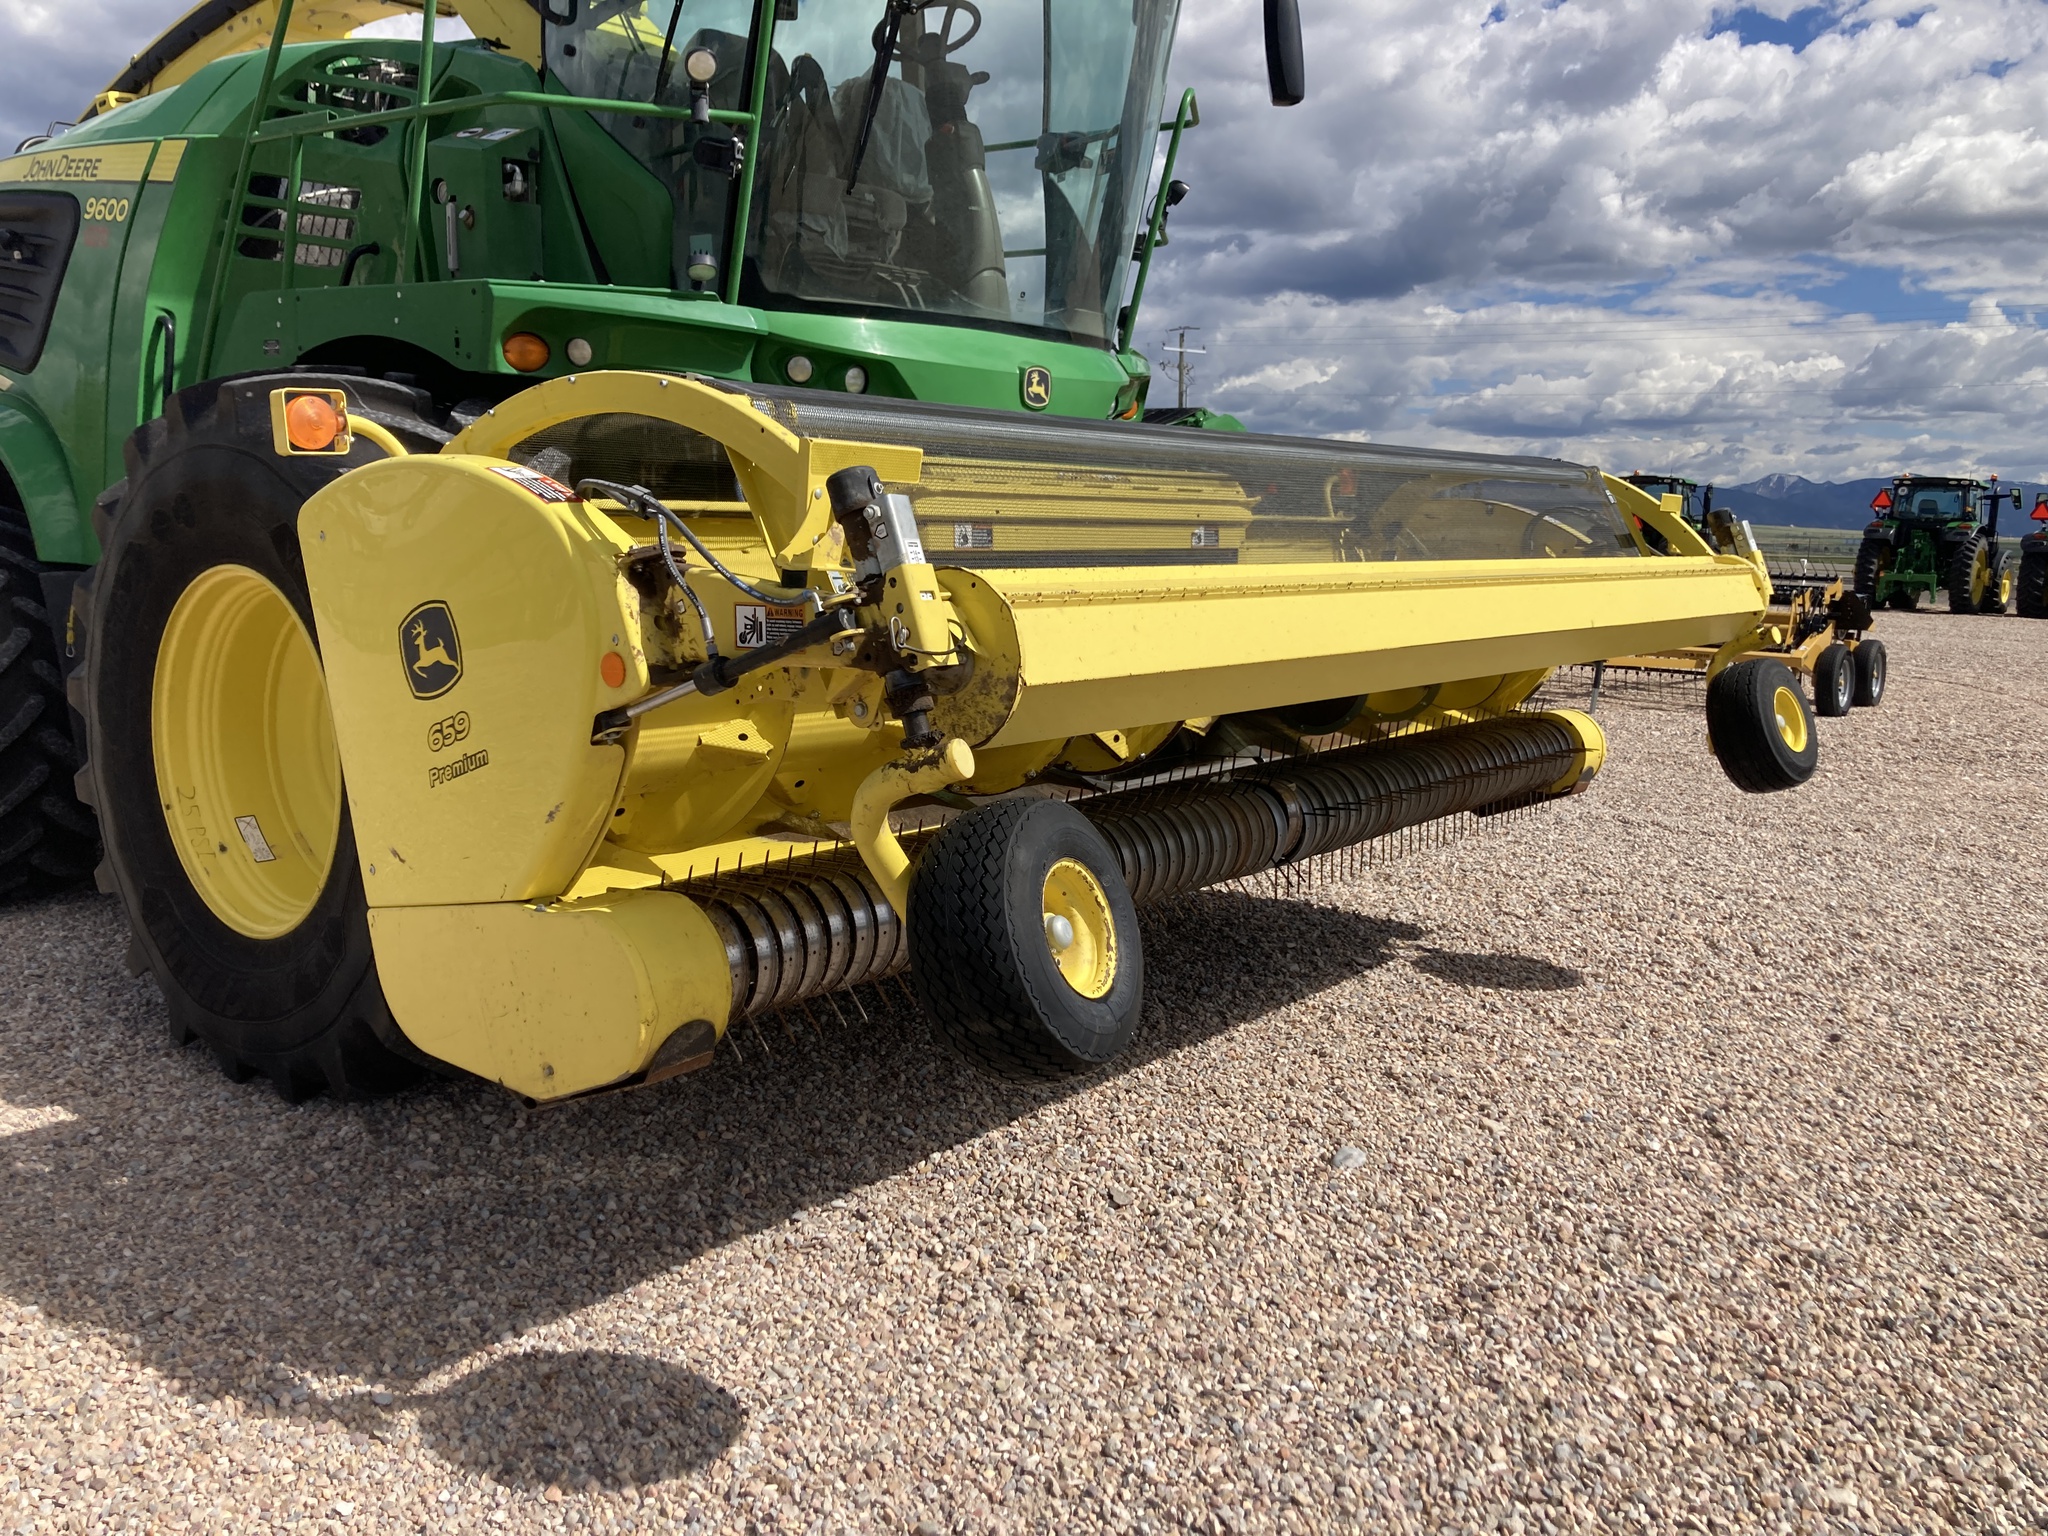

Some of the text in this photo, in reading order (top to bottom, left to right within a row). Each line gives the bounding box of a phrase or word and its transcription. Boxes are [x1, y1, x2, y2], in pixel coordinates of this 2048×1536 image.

[22, 154, 103, 179] JOHN DEERE
[83, 196, 130, 223] 9600
[775, 608, 804, 618] WARNING
[427, 710, 471, 753] 659
[428, 749, 490, 789] Premium
